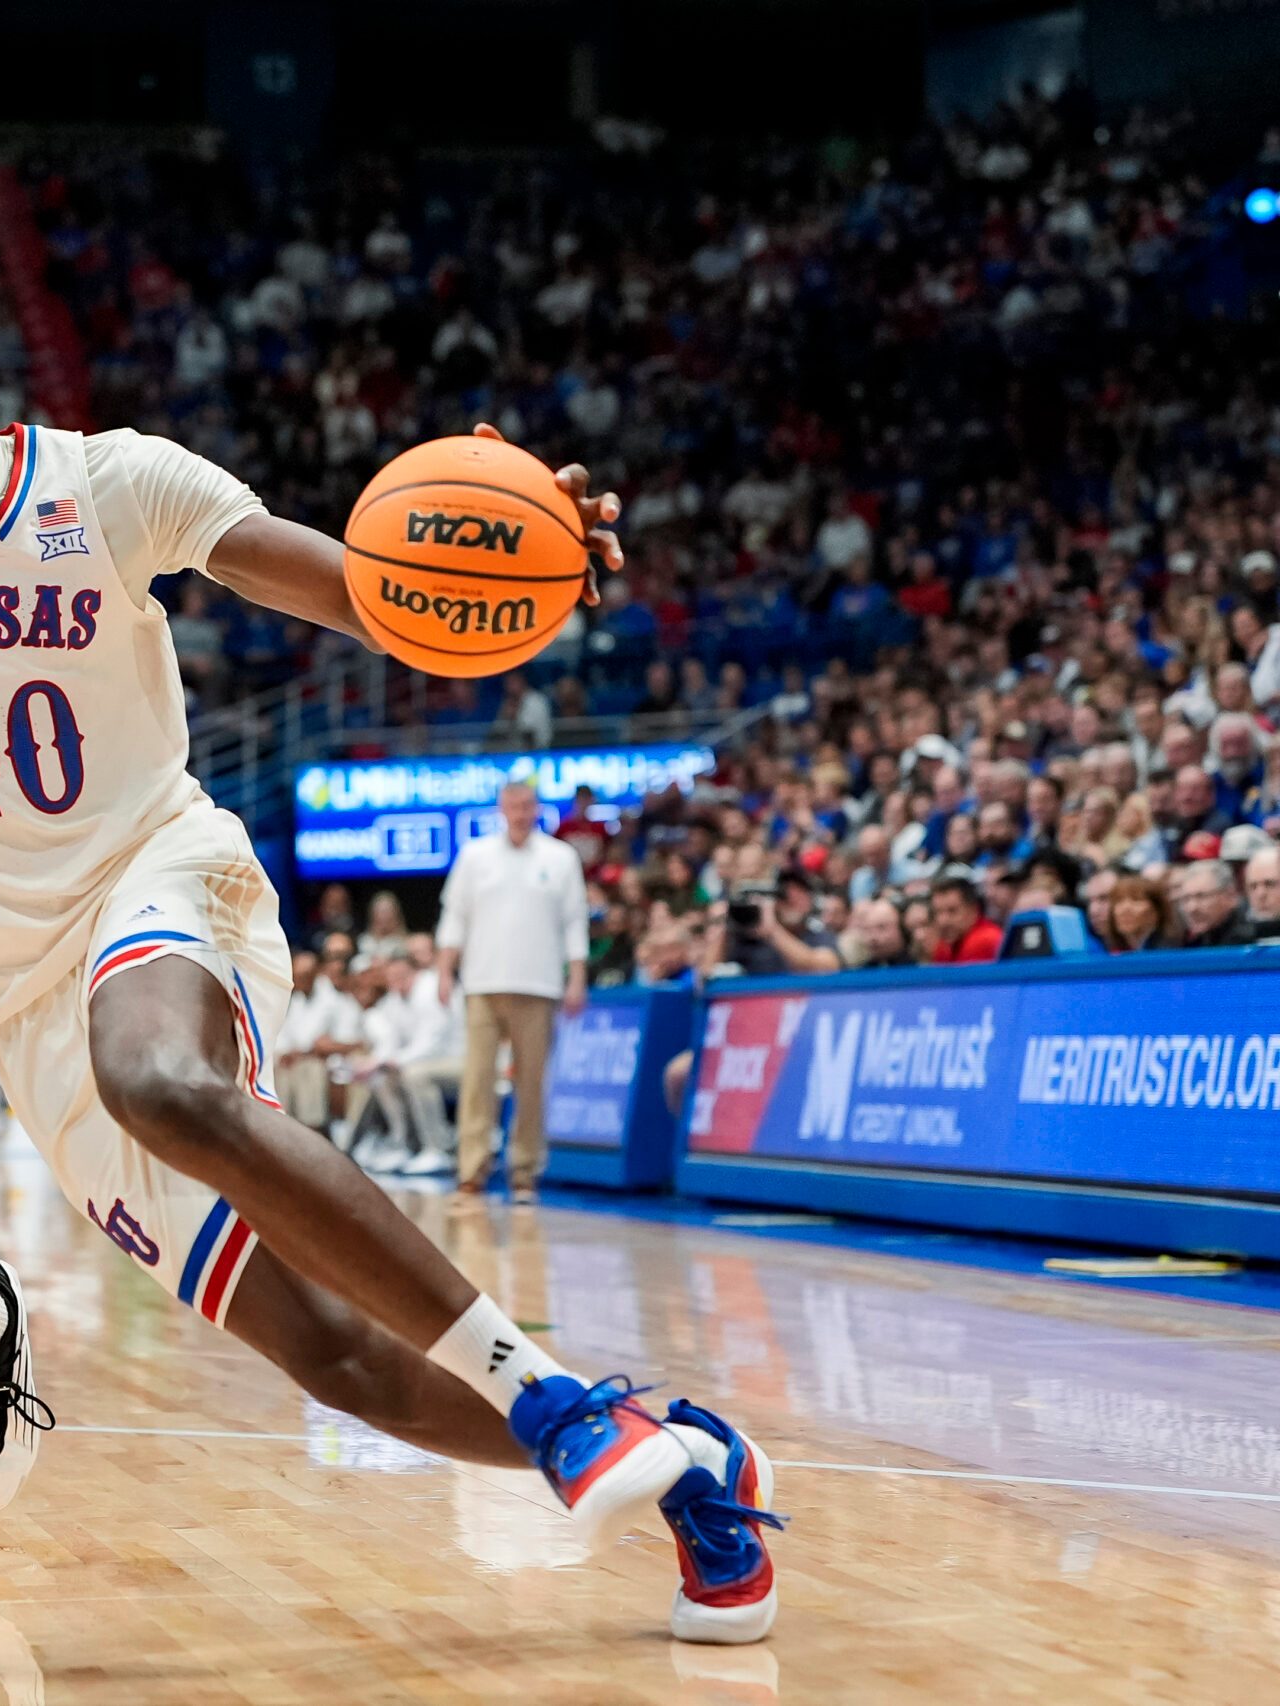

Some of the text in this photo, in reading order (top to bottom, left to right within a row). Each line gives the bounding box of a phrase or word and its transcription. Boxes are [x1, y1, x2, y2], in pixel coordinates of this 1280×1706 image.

[407, 511, 524, 555] NCAA
[380, 575, 536, 635] Wilson
[858, 1006, 995, 1090] Meritrust
